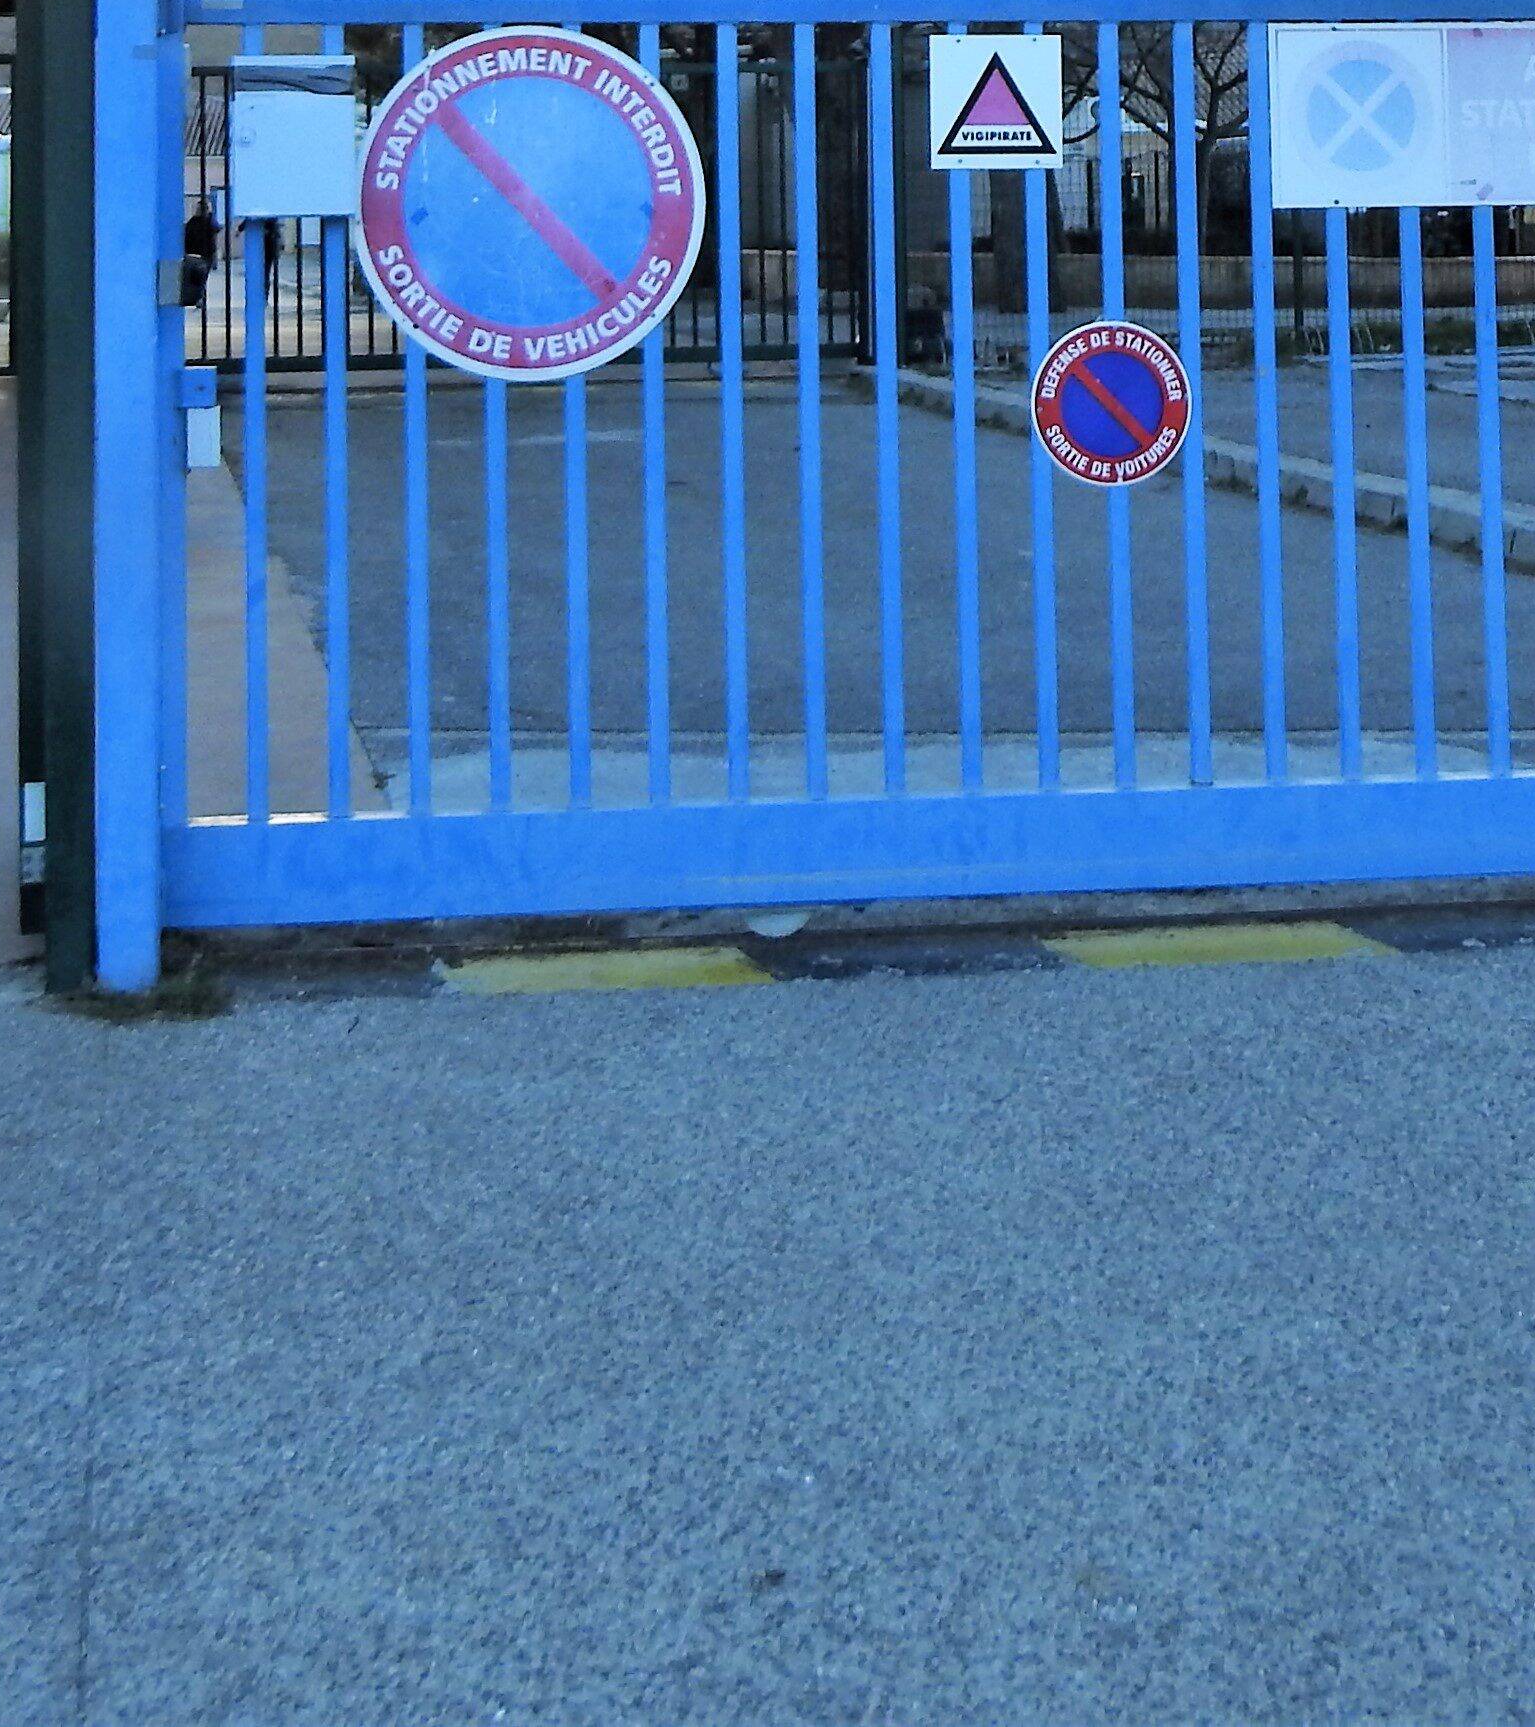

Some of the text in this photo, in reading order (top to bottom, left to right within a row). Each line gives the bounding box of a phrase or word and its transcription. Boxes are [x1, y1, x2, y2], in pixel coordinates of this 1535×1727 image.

[376, 47, 683, 196] STATIONNEMENT INTERDIT
[961, 131, 1032, 141] VIGIPIRATE
[377, 245, 673, 362] SORTIE DE VEHICULES
[1041, 331, 1183, 401] DEFENSE DE STATIONNER
[1046, 425, 1177, 477] SORTIE DE VOITURES
